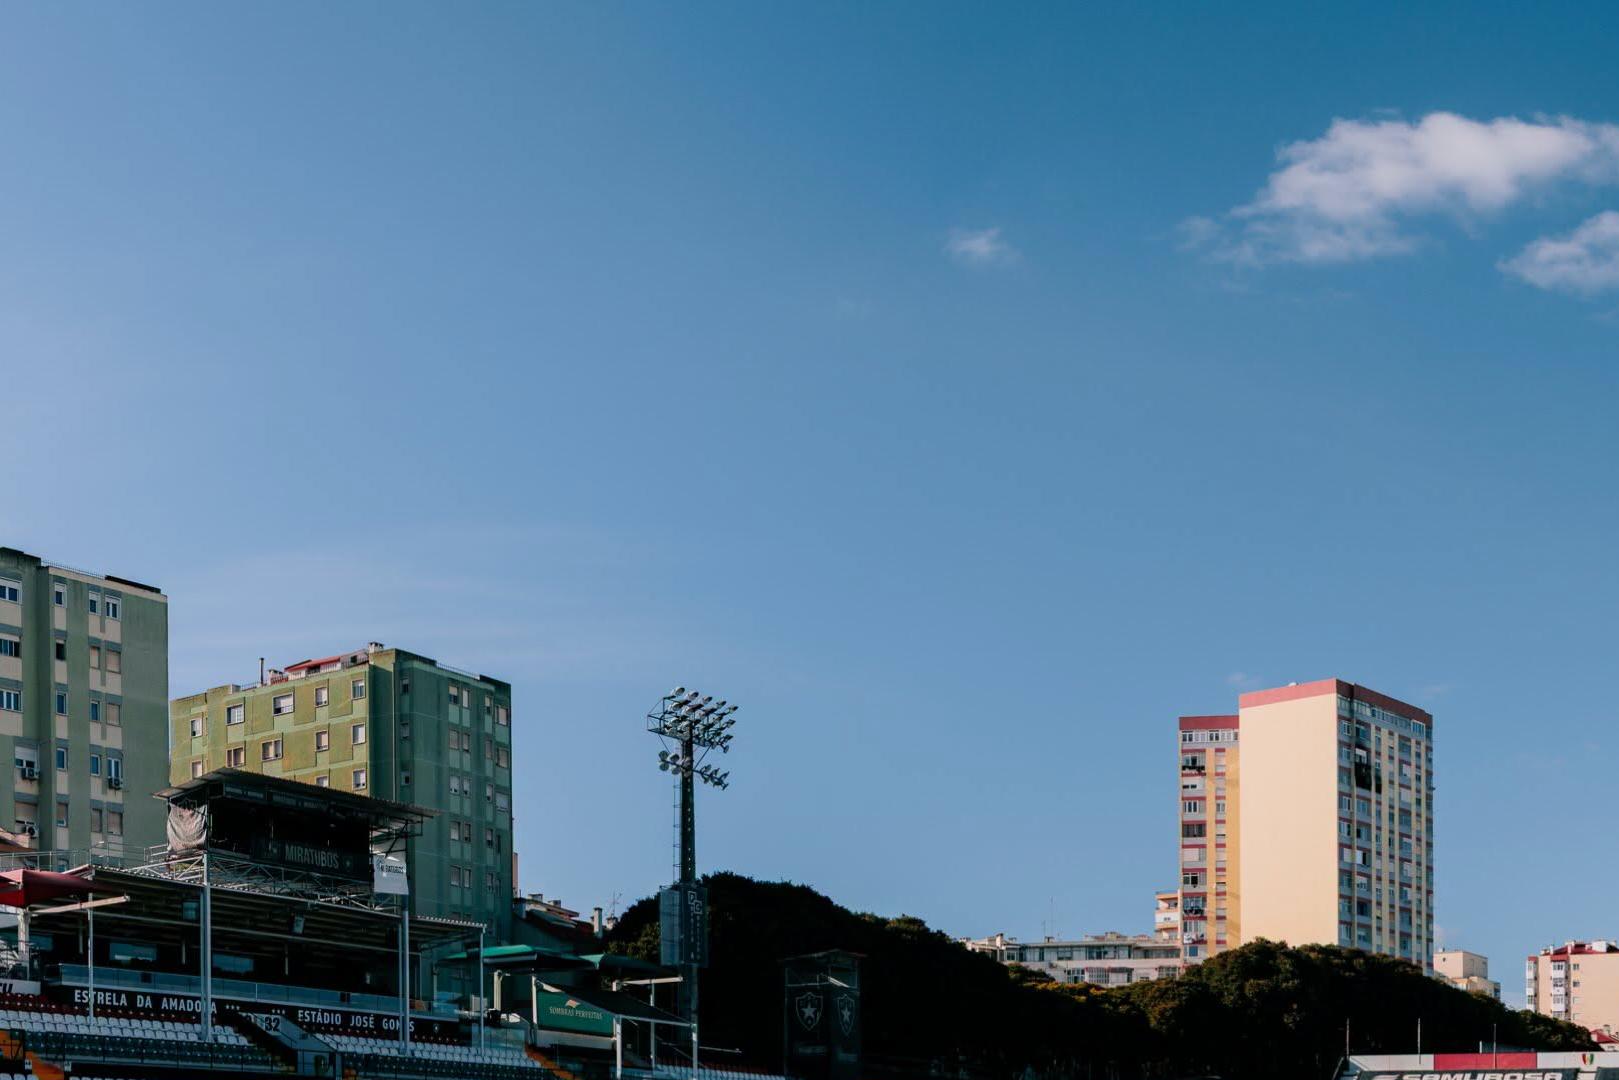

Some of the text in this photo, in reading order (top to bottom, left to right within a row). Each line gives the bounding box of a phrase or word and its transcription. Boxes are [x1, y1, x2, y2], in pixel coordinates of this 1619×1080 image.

[137, 995, 153, 1009] DA
[161, 999, 217, 1014] AMADOA
[298, 1008, 342, 1025] ESTÁDIO
[350, 1013, 375, 1029] JOSÉ
